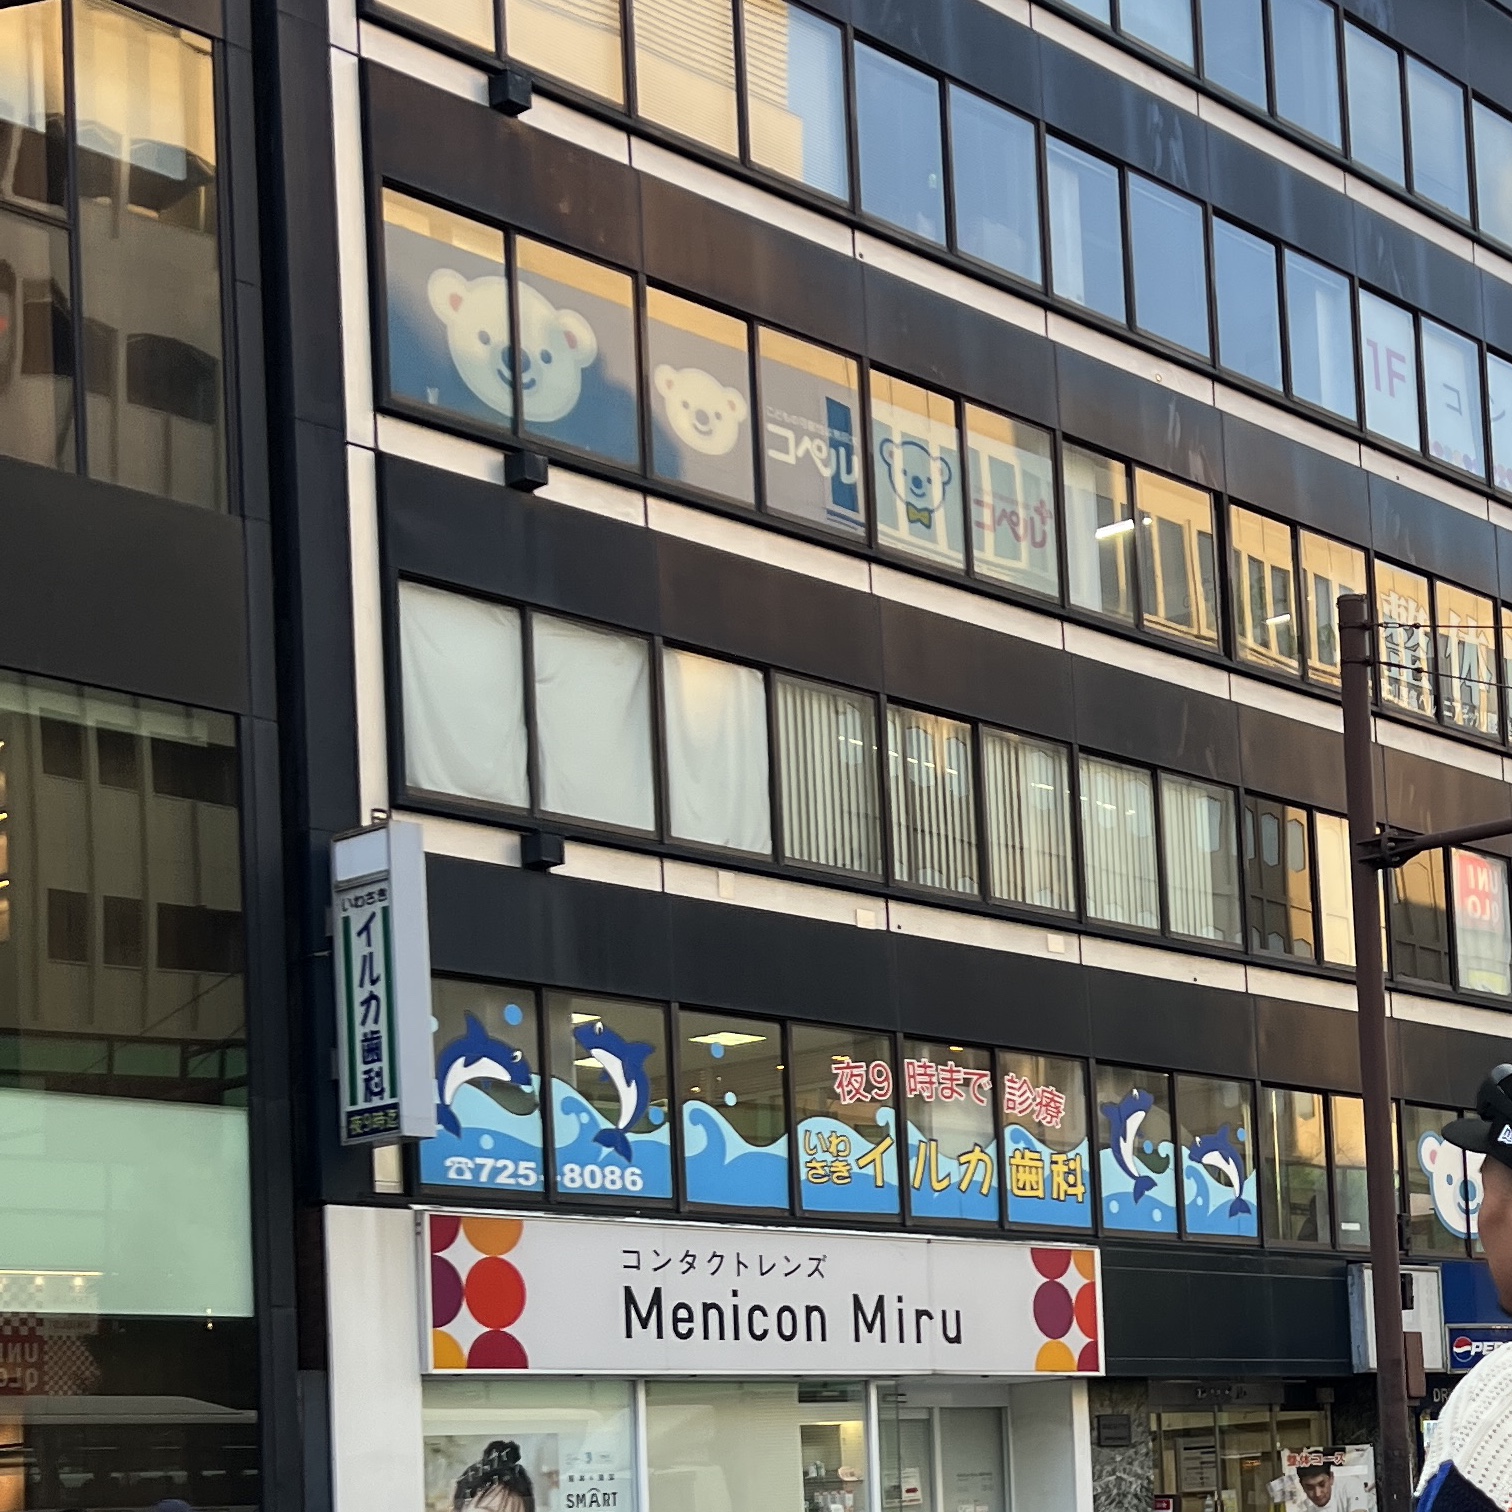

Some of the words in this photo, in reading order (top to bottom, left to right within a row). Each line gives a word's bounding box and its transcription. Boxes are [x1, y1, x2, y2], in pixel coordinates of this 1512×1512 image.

[1366, 338, 1406, 398] 1F
[341, 887, 388, 913] いわさき
[356, 910, 386, 1102] イルカ歯科
[831, 1058, 1066, 1130] 夜9時まで診療
[803, 1129, 851, 1157] いわ
[805, 1157, 852, 1185] さき
[855, 1134, 1087, 1204] イルカ歯科
[622, 1249, 828, 1279] コンタクトレンズ
[623, 1285, 828, 1342] Menicon
[852, 1293, 963, 1345] Miru
[565, 1488, 618, 1509] SMART
